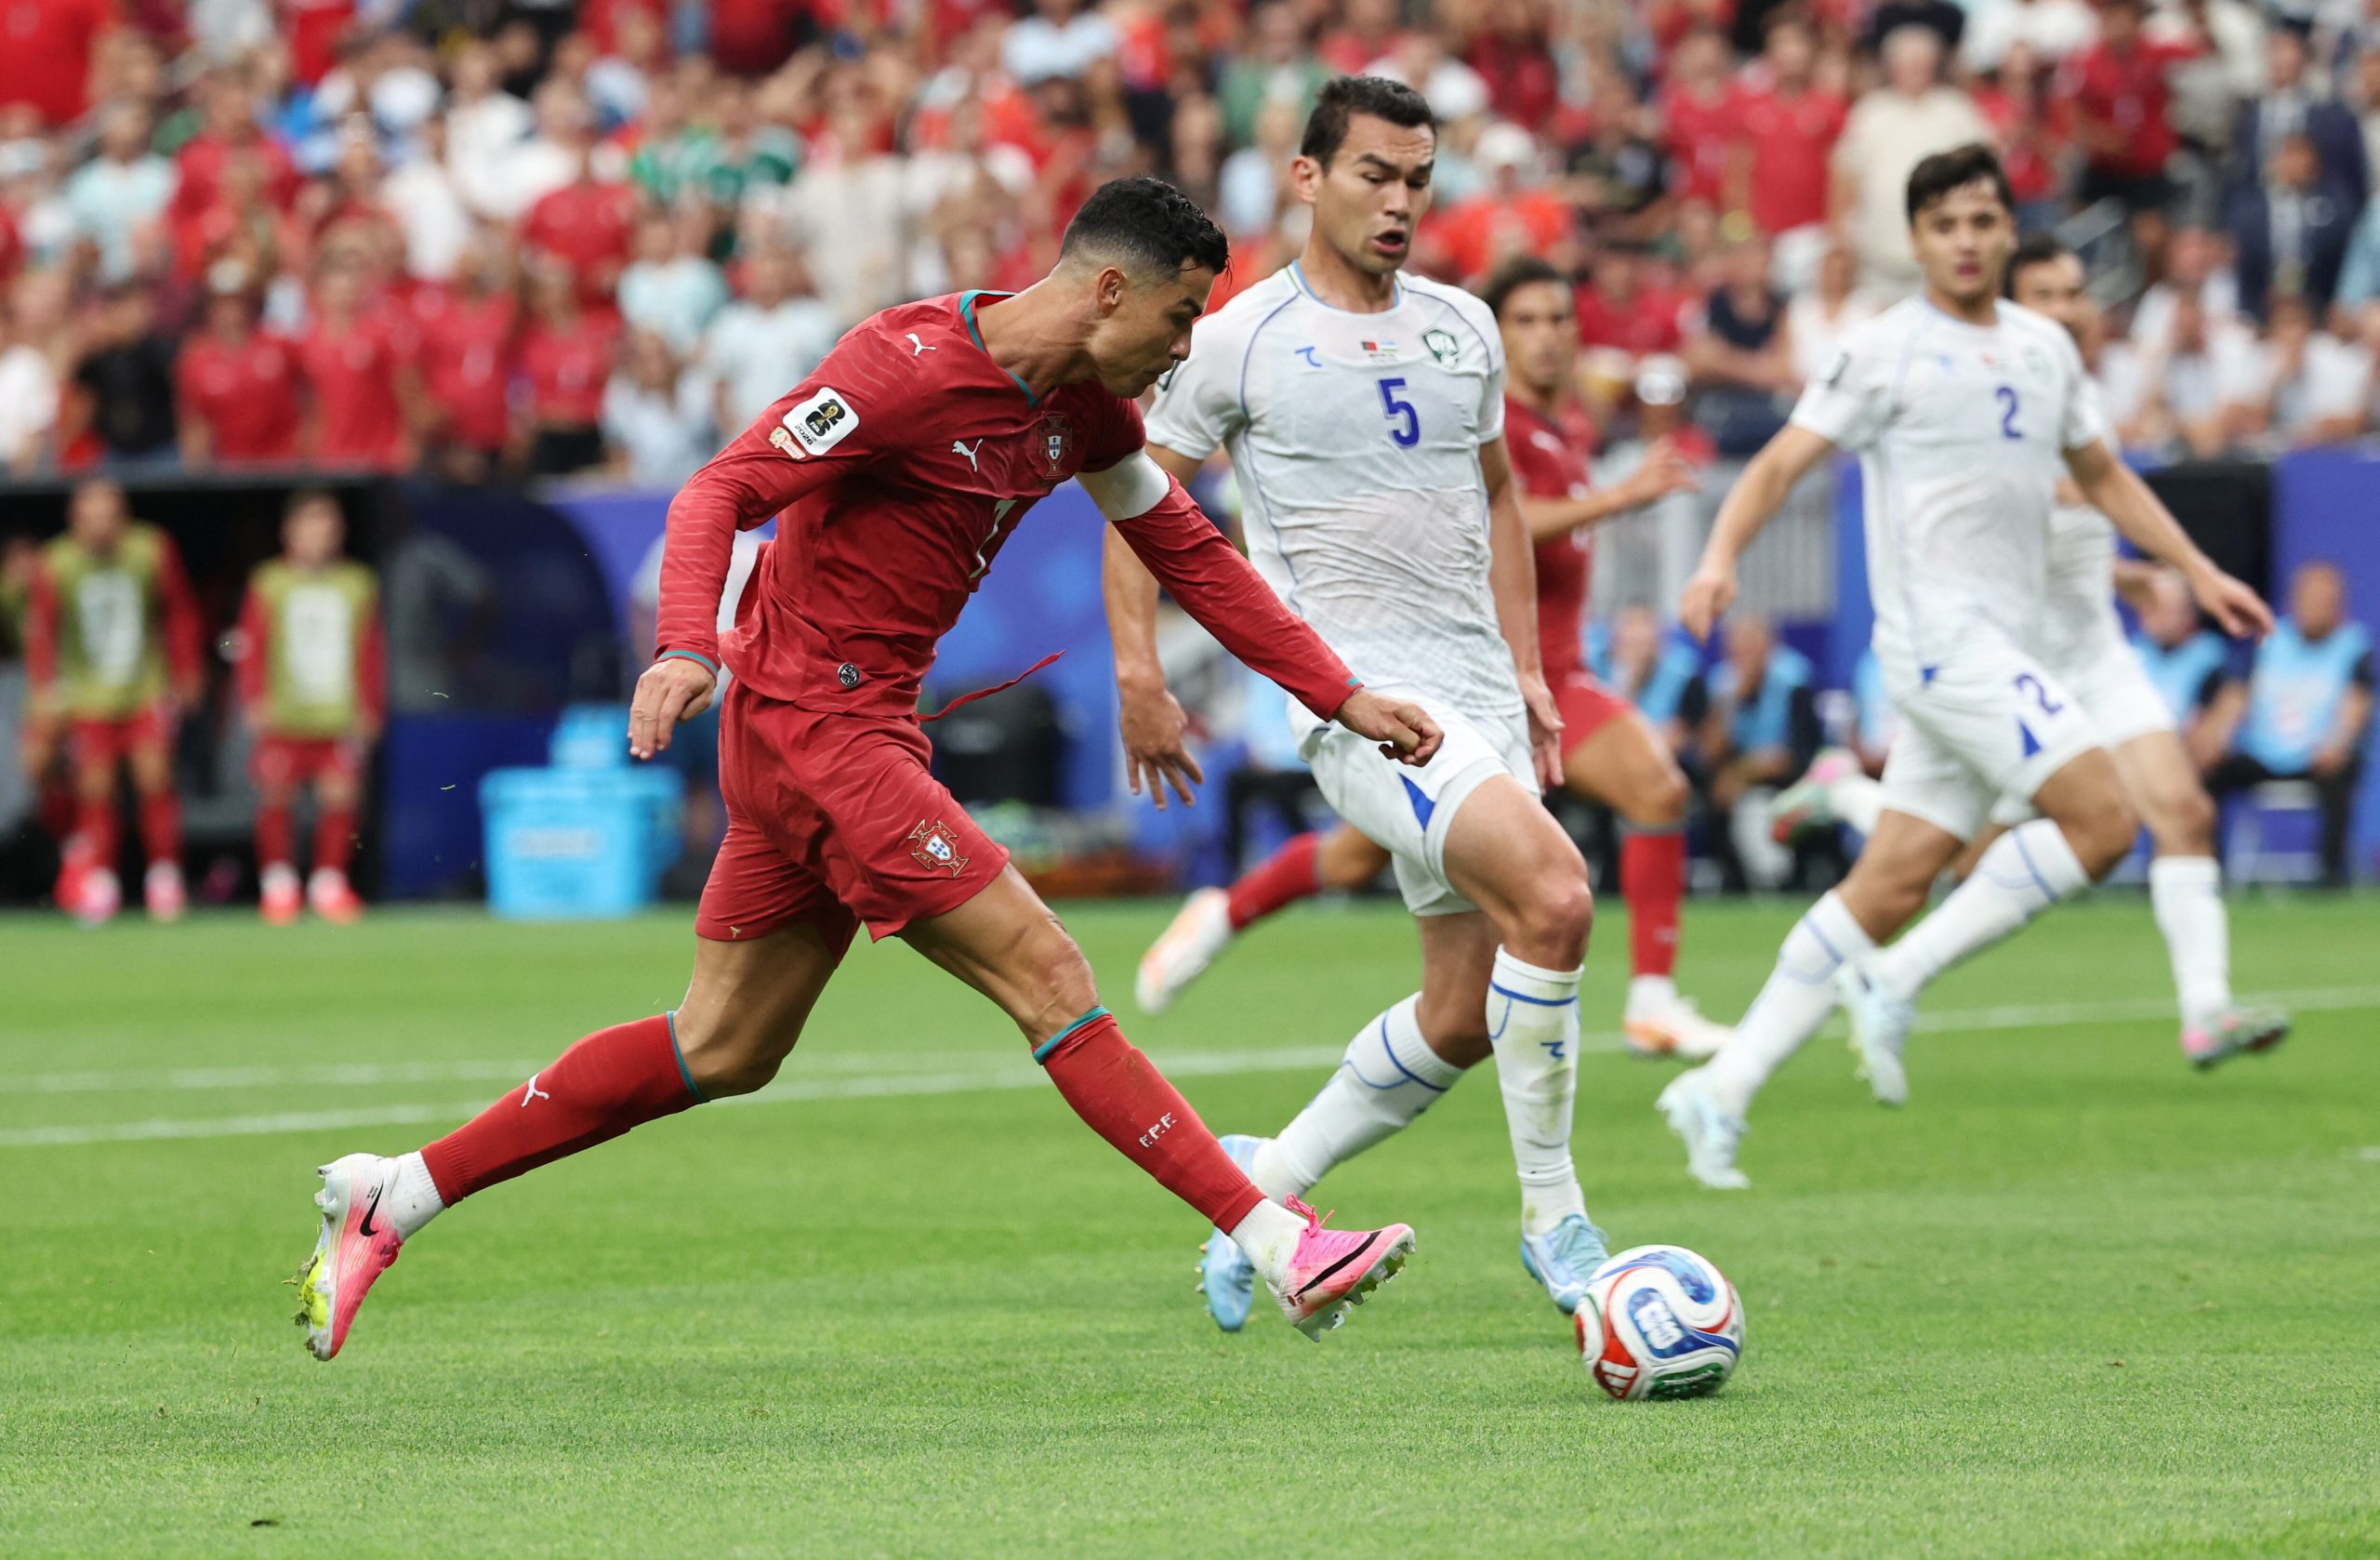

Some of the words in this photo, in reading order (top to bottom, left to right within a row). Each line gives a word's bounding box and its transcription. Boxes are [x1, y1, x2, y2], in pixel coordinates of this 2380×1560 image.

[794, 424, 813, 445] 2026
[1377, 377, 1420, 449] 5
[1996, 387, 2023, 439] 2
[2014, 672, 2064, 716] 2
